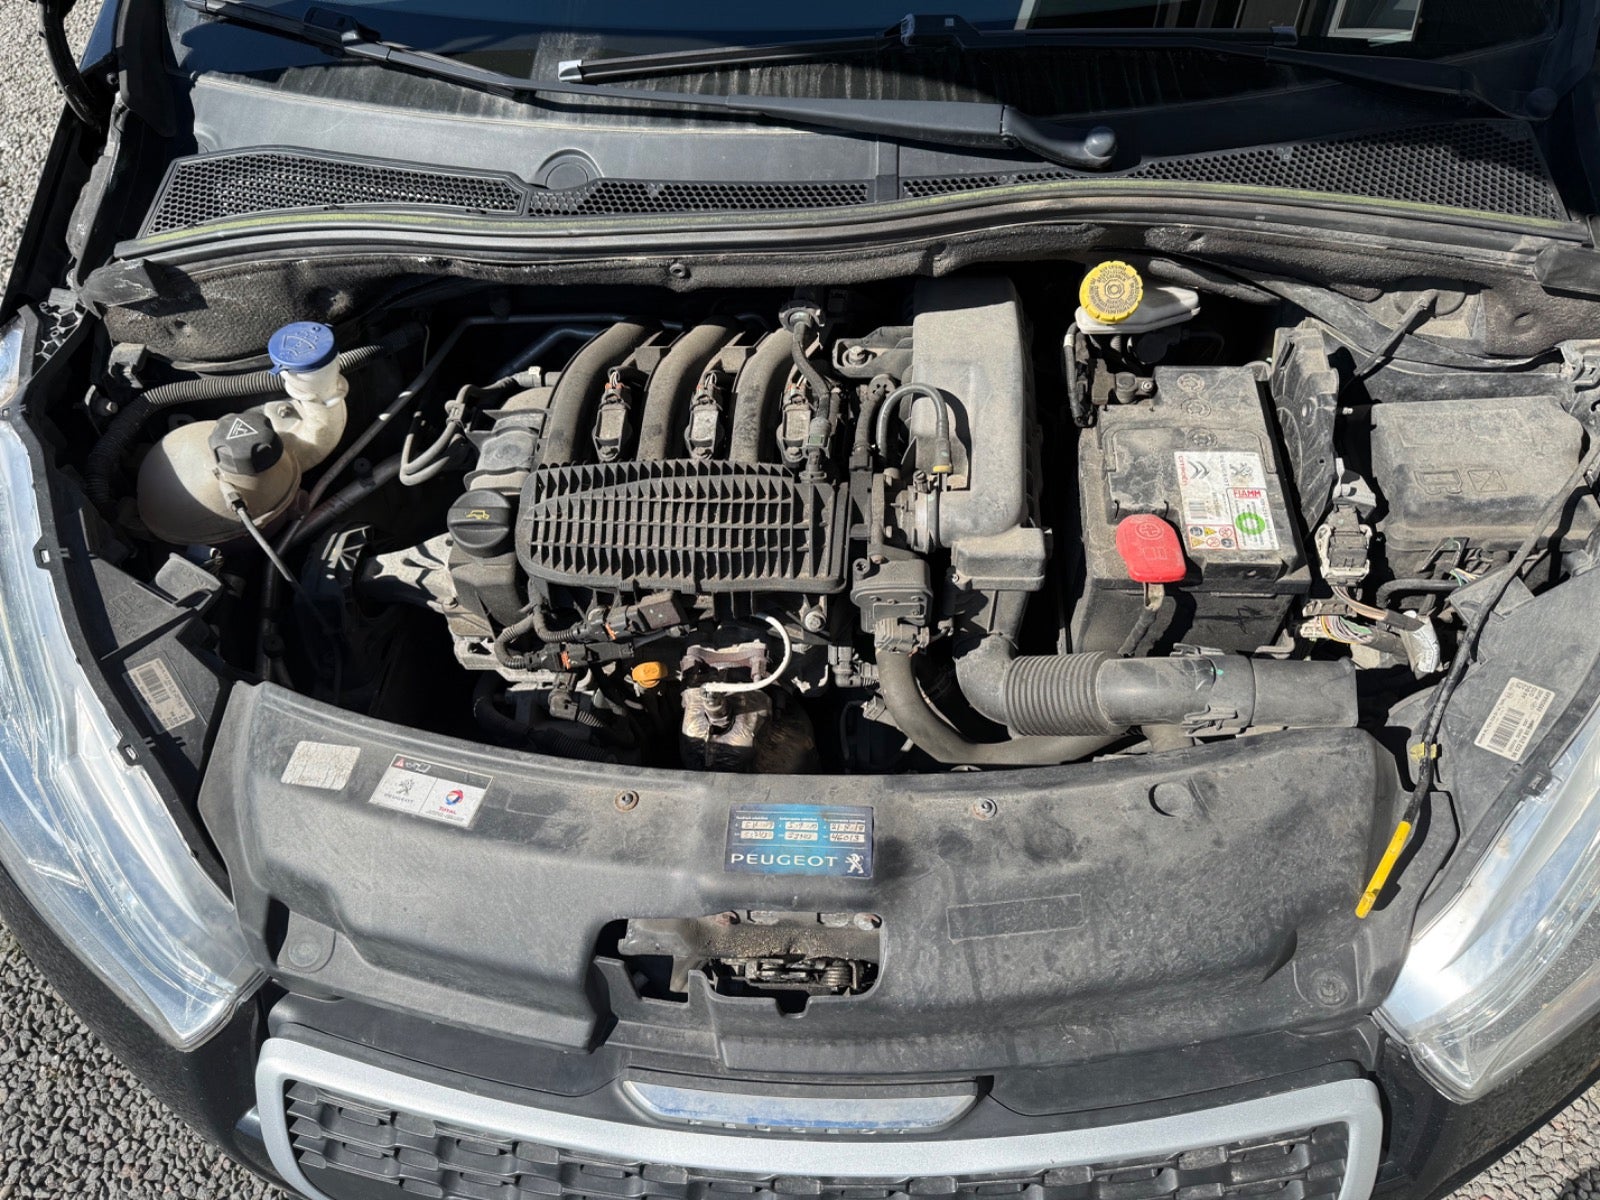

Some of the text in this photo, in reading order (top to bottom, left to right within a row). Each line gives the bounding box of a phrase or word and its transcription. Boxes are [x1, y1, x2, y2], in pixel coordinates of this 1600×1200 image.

[1219, 455, 1230, 487] PEUGEOT
[1233, 488, 1262, 499] FIAMM
[383, 792, 414, 804] PEUGEOT
[438, 806, 457, 815] TOTAL
[731, 853, 839, 867] PEUGEOT
